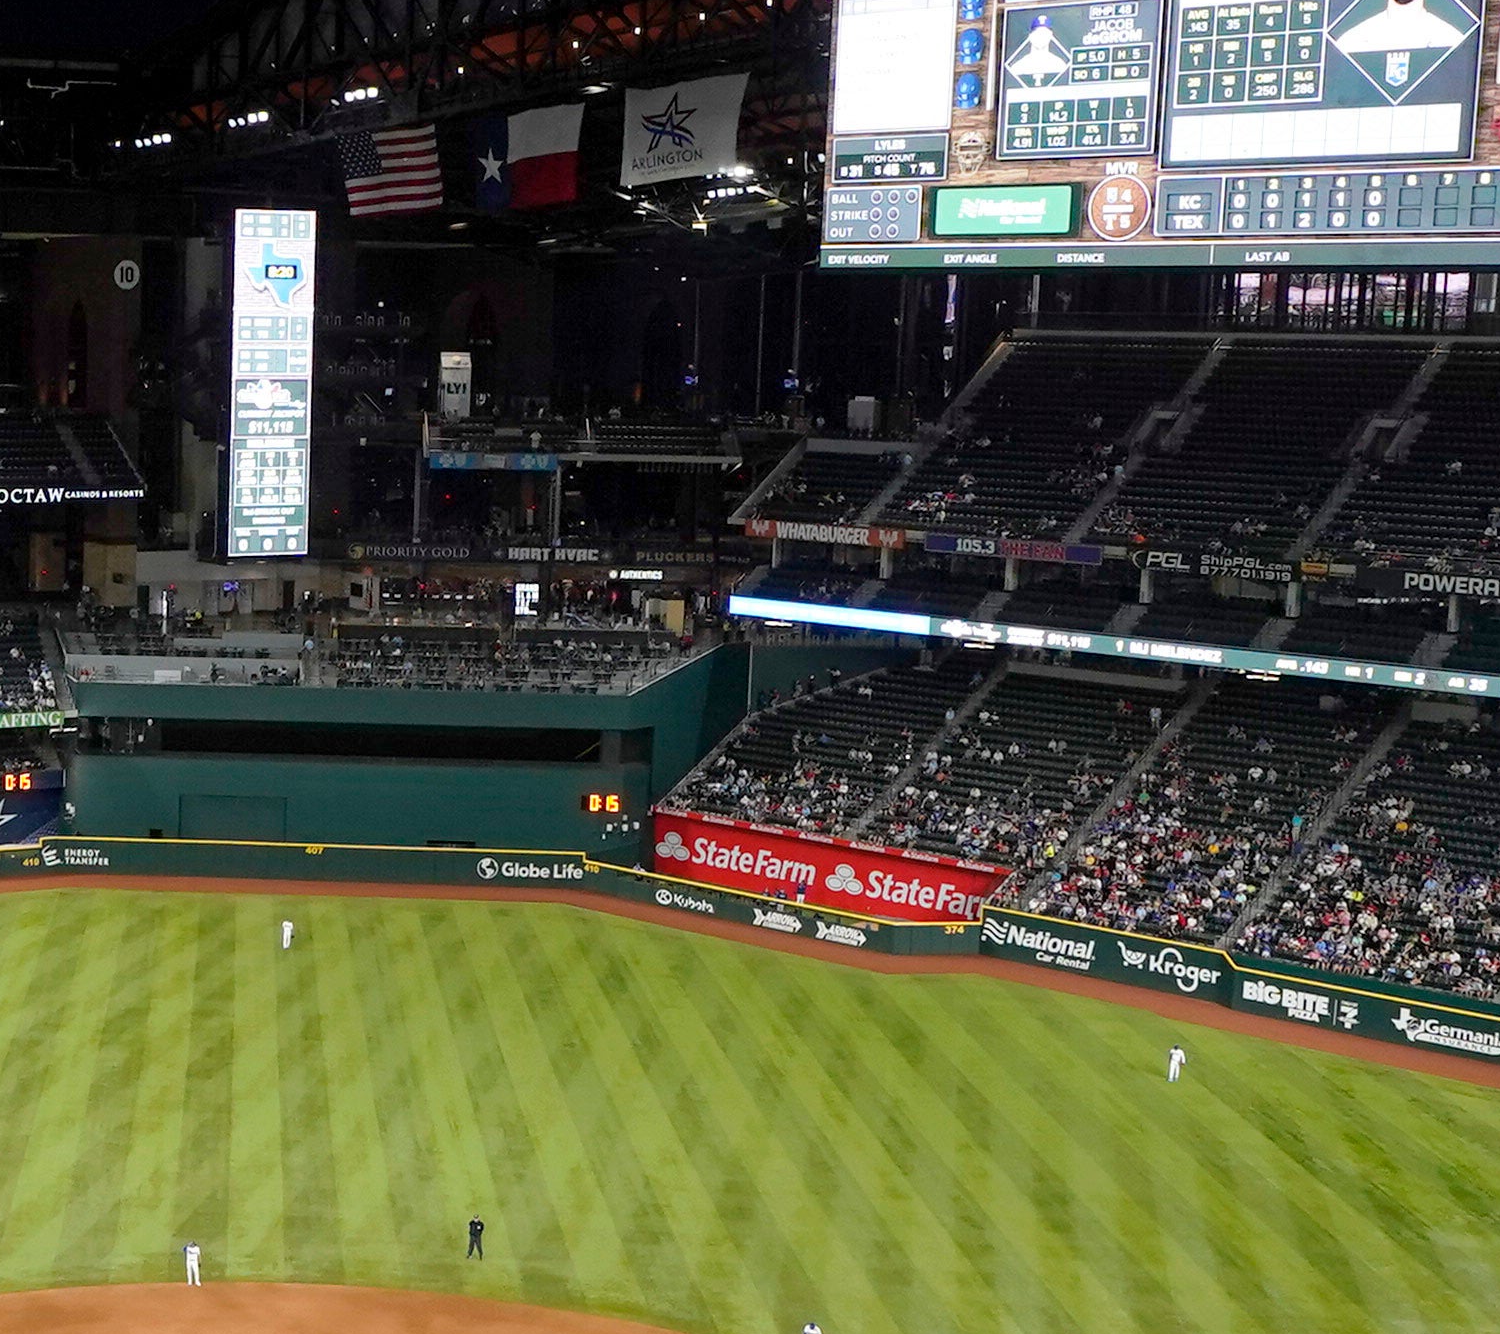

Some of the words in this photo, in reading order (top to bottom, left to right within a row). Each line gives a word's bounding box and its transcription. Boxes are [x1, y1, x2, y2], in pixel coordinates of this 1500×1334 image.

[1091, 18, 1134, 33] JACOB
[1082, 29, 1143, 45] deGROM
[631, 149, 703, 170] ARLINGTON
[1105, 162, 1139, 175] MVR
[831, 193, 859, 205] BALL
[1178, 194, 1202, 210] KC
[830, 209, 869, 221] STRIKE
[1173, 215, 1205, 230] TEX
[830, 226, 854, 238] OUT
[828, 254, 846, 265] EXIT
[847, 253, 889, 265] VELOCITY
[944, 253, 962, 264] EXIT
[963, 253, 997, 264] ANGLE
[1057, 252, 1105, 263] DISTANCE
[1245, 251, 1272, 262] LAST
[1273, 251, 1290, 262] AB
[118, 264, 135, 284] 10
[64, 490, 100, 499] CASINOS
[109, 489, 144, 498] RESORTS
[776, 522, 869, 546] WHATABURGER
[365, 546, 427, 559] PRIORITY
[430, 546, 470, 559] GOLD
[508, 547, 550, 561] HART
[555, 548, 599, 562] HVAC
[955, 537, 995, 554] 105.3
[1003, 540, 1028, 558] THE
[1031, 543, 1067, 561] FAN
[636, 551, 714, 563] PLUCKERS
[1146, 551, 1191, 569] PGL
[1200, 554, 1292, 571] ShipPGL.com
[619, 570, 663, 580] AUTHENTICS
[4, 774, 31, 790] 0:15
[588, 794, 619, 813] 0:15
[65, 848, 101, 858] ENERGY
[305, 846, 325, 855] 407
[65, 856, 109, 867] TRANSFER
[501, 861, 551, 879] Globe
[553, 863, 584, 879] Life
[673, 893, 715, 915] Kubota
[765, 912, 796, 927] ARROW
[827, 927, 861, 941] ARROW
[945, 925, 964, 935] 374
[1006, 922, 1096, 960] National
[1036, 951, 1055, 964] Car
[1055, 956, 1090, 971] Rental
[1149, 947, 1221, 993] Kroger
[1282, 990, 1331, 1016] BITE
[1287, 1007, 1321, 1024] PIZZA
[1429, 1034, 1493, 1055] INSURANCE
